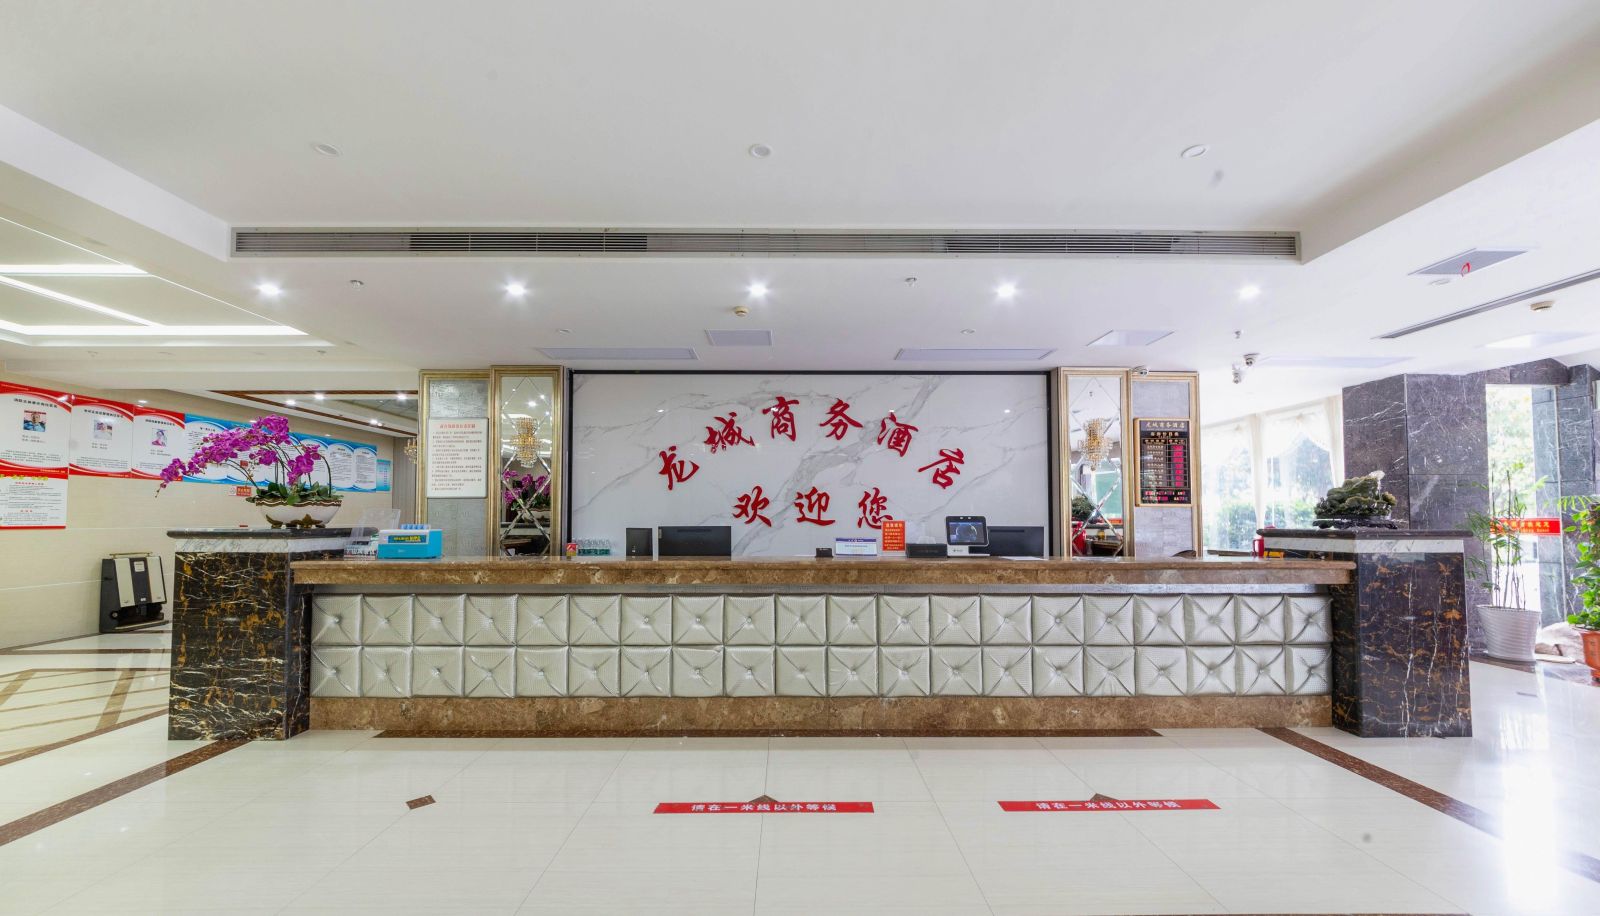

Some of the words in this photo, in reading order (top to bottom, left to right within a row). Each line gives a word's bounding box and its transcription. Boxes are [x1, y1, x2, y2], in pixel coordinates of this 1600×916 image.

[659, 396, 965, 491] 龙城商务酒店
[733, 485, 895, 529] 欢迎您
[1036, 801, 1181, 810] 请在一米线以外等候
